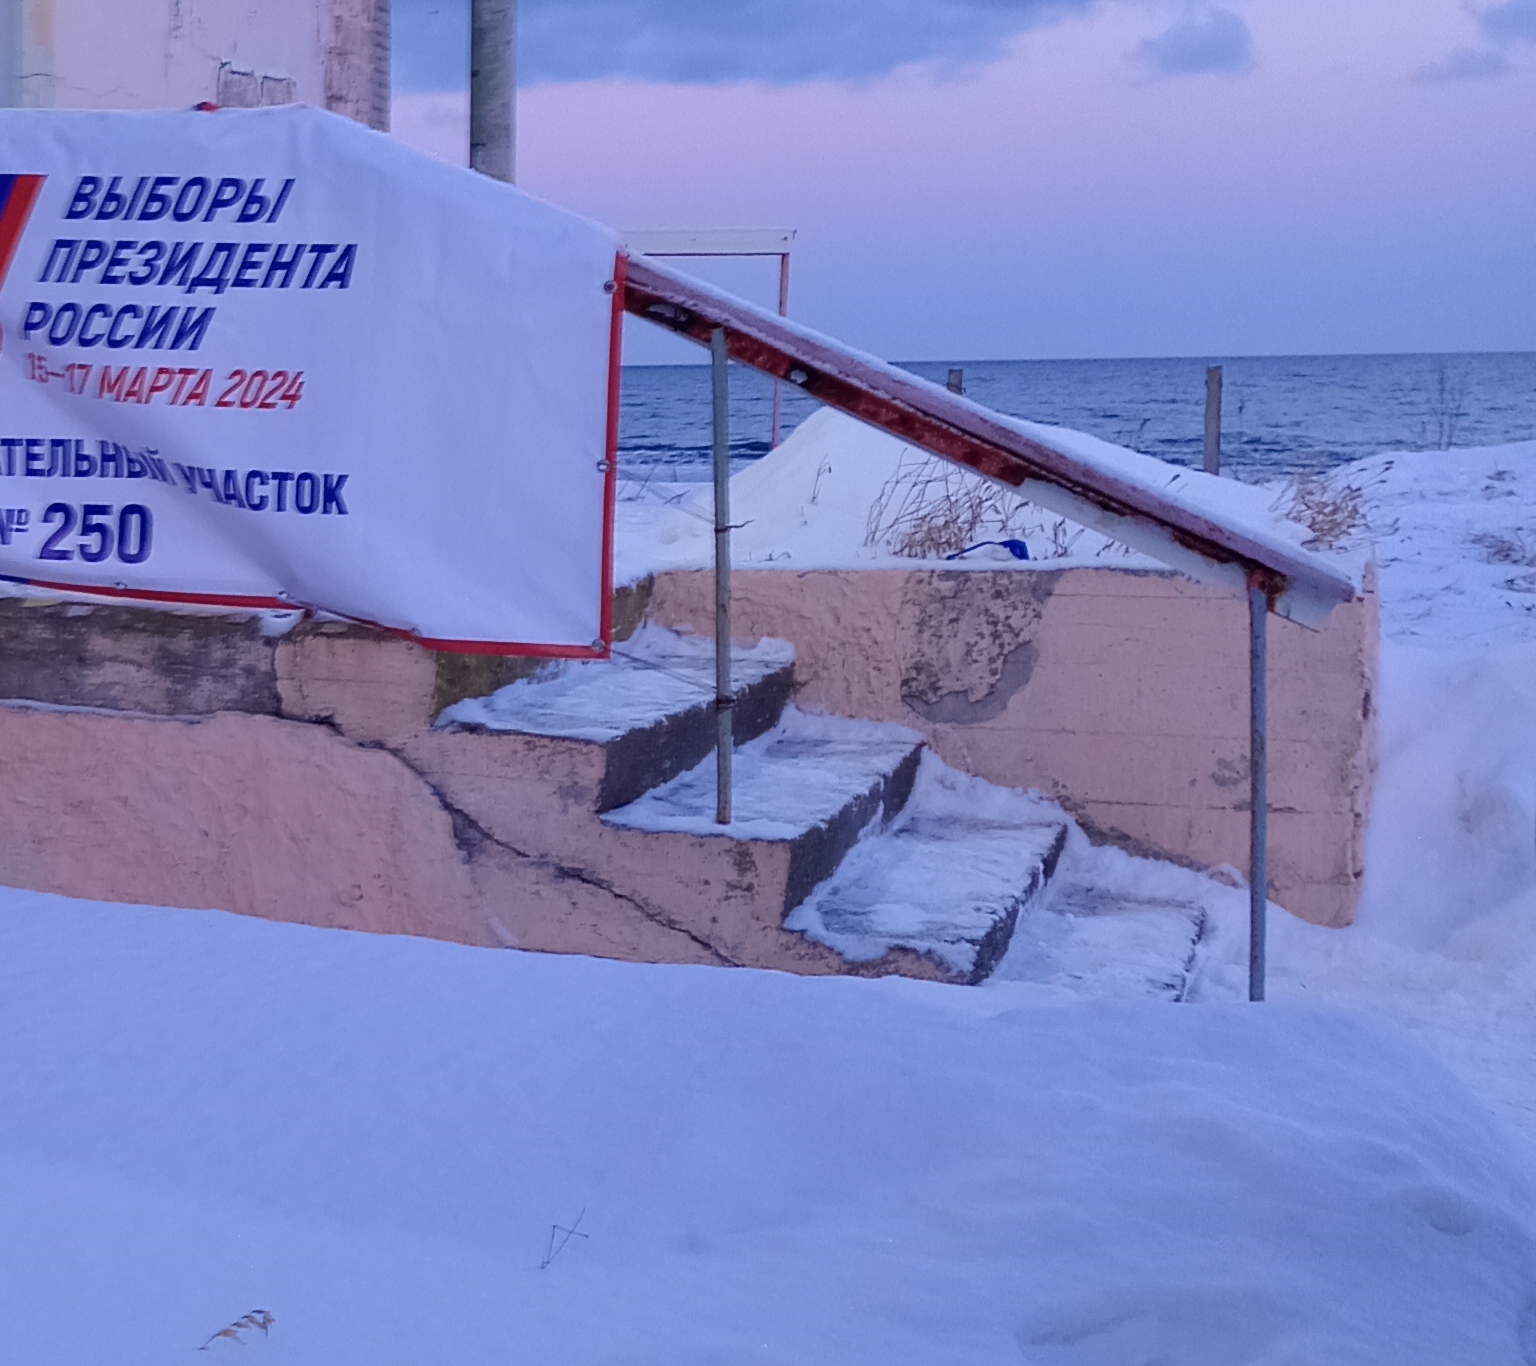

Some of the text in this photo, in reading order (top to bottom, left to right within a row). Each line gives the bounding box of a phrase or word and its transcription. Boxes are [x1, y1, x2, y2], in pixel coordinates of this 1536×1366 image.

[62, 175, 295, 223] ВЫБОРЫ
[39, 239, 358, 294] ПРЕЗИДЕНТА
[24, 302, 216, 350] РОССИИ
[97, 365, 216, 406] МАРТА
[215, 369, 305, 409] 2024
[171, 463, 349, 514] УЧАСТОК
[38, 502, 153, 563] 250
